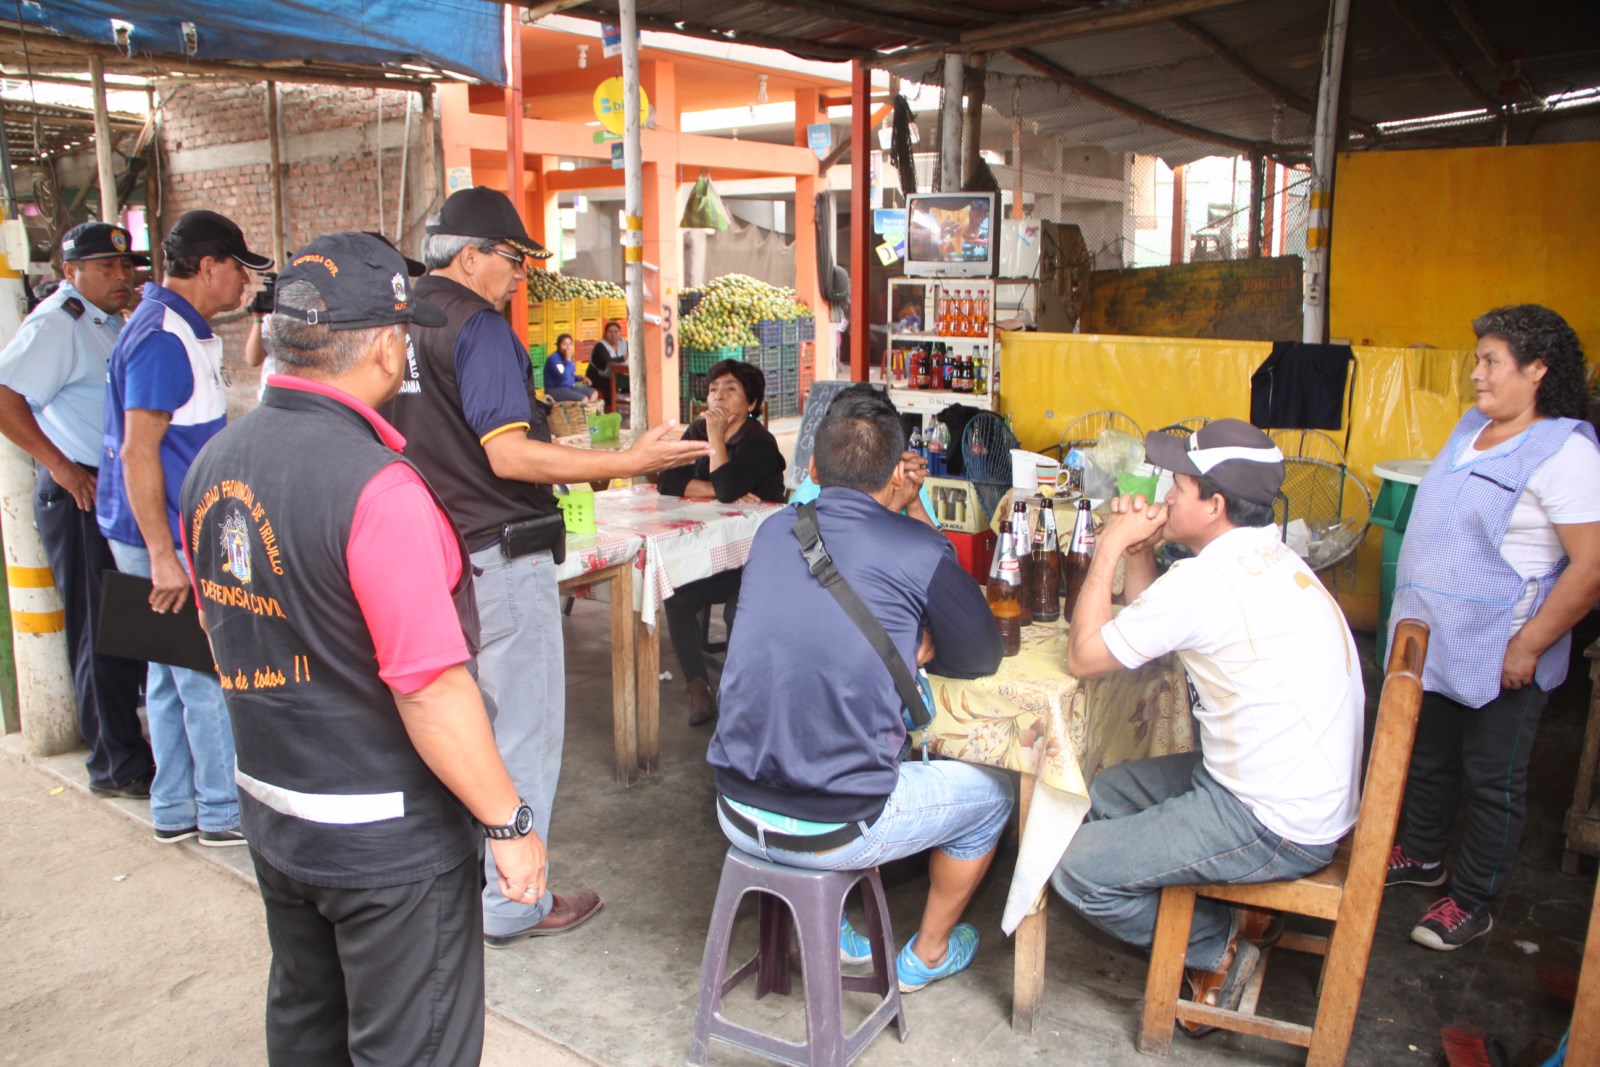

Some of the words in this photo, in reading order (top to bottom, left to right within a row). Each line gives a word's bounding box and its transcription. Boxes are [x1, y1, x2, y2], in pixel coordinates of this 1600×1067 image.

[192, 484, 220, 554] MUNICIPALIDAD
[251, 501, 266, 523] DE
[258, 518, 285, 576] TRUJILLO
[200, 578, 251, 610] DEFENSA
[250, 593, 288, 620] CIVIL
[235, 668, 248, 690] de
[253, 665, 286, 689] todos
